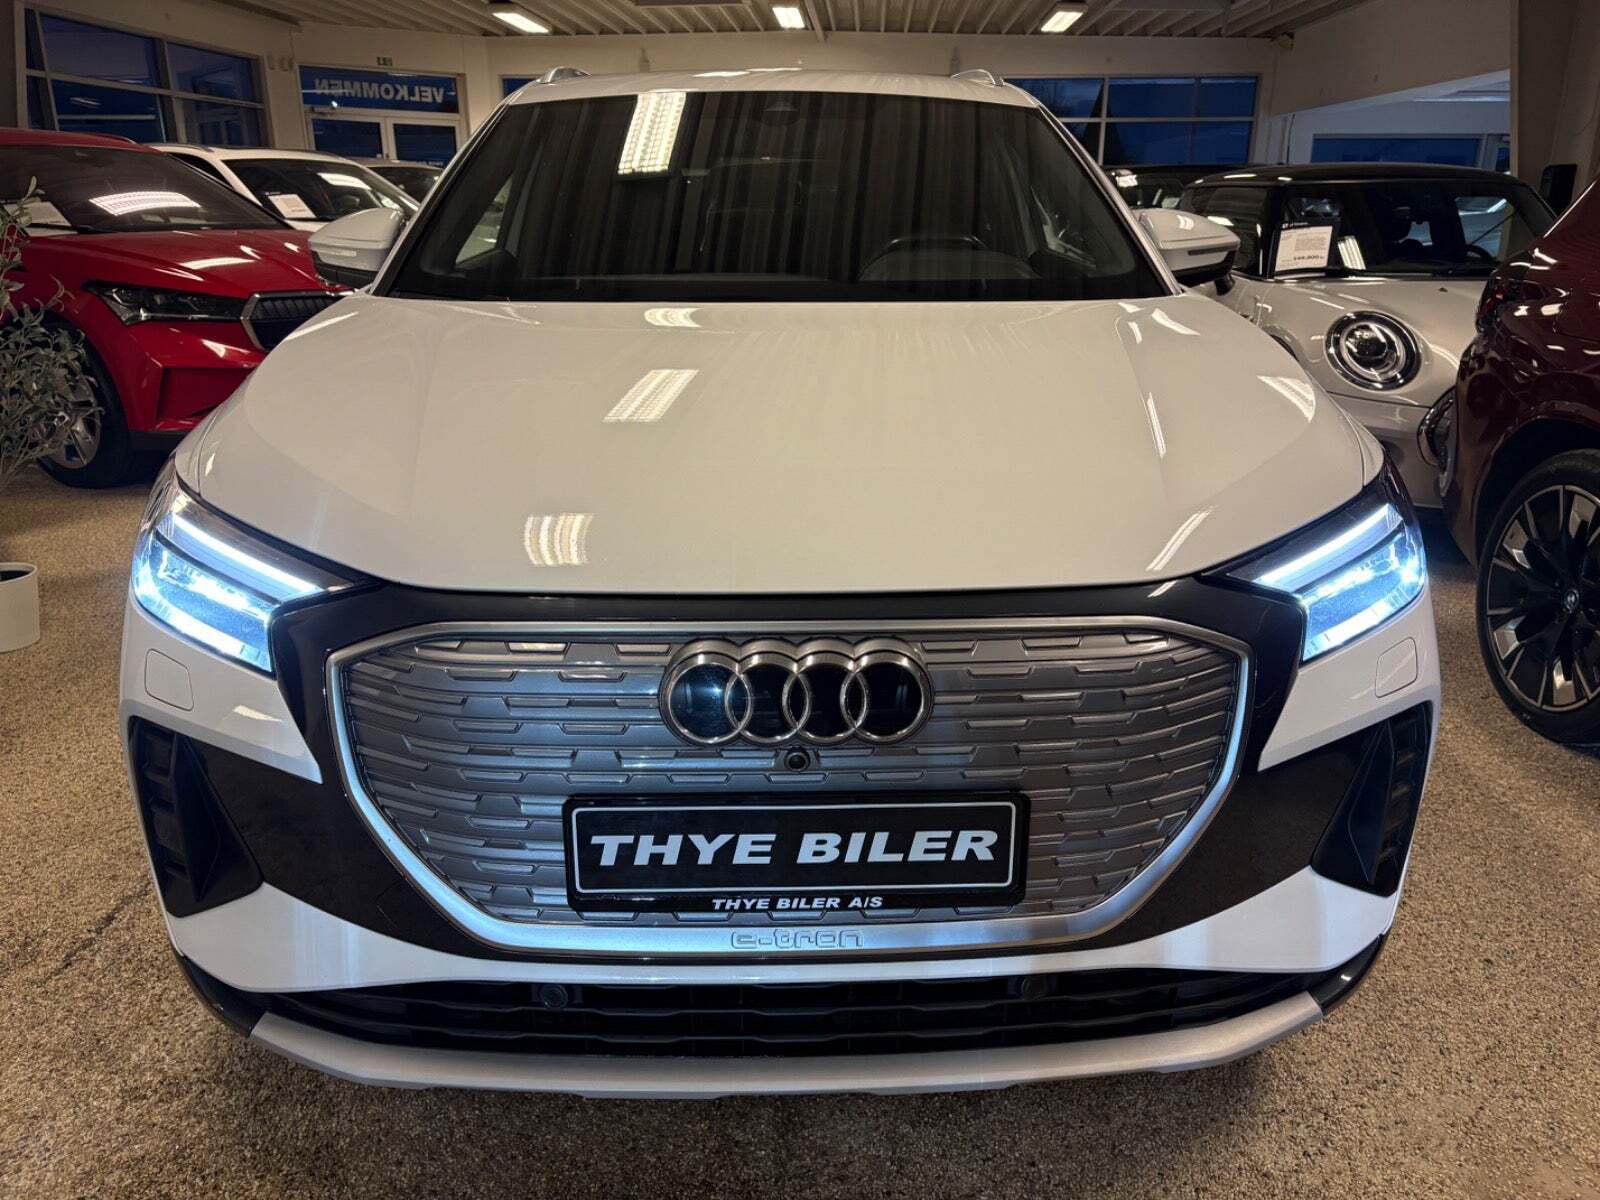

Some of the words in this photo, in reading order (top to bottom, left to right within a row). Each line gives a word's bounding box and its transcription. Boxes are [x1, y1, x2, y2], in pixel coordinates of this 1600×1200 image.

[591, 833, 776, 866] THYE
[796, 830, 998, 864] BILER
[711, 898, 770, 910] THYE
[776, 897, 840, 910] BILER
[848, 896, 883, 908] A/S
[731, 928, 864, 949] e-tron
